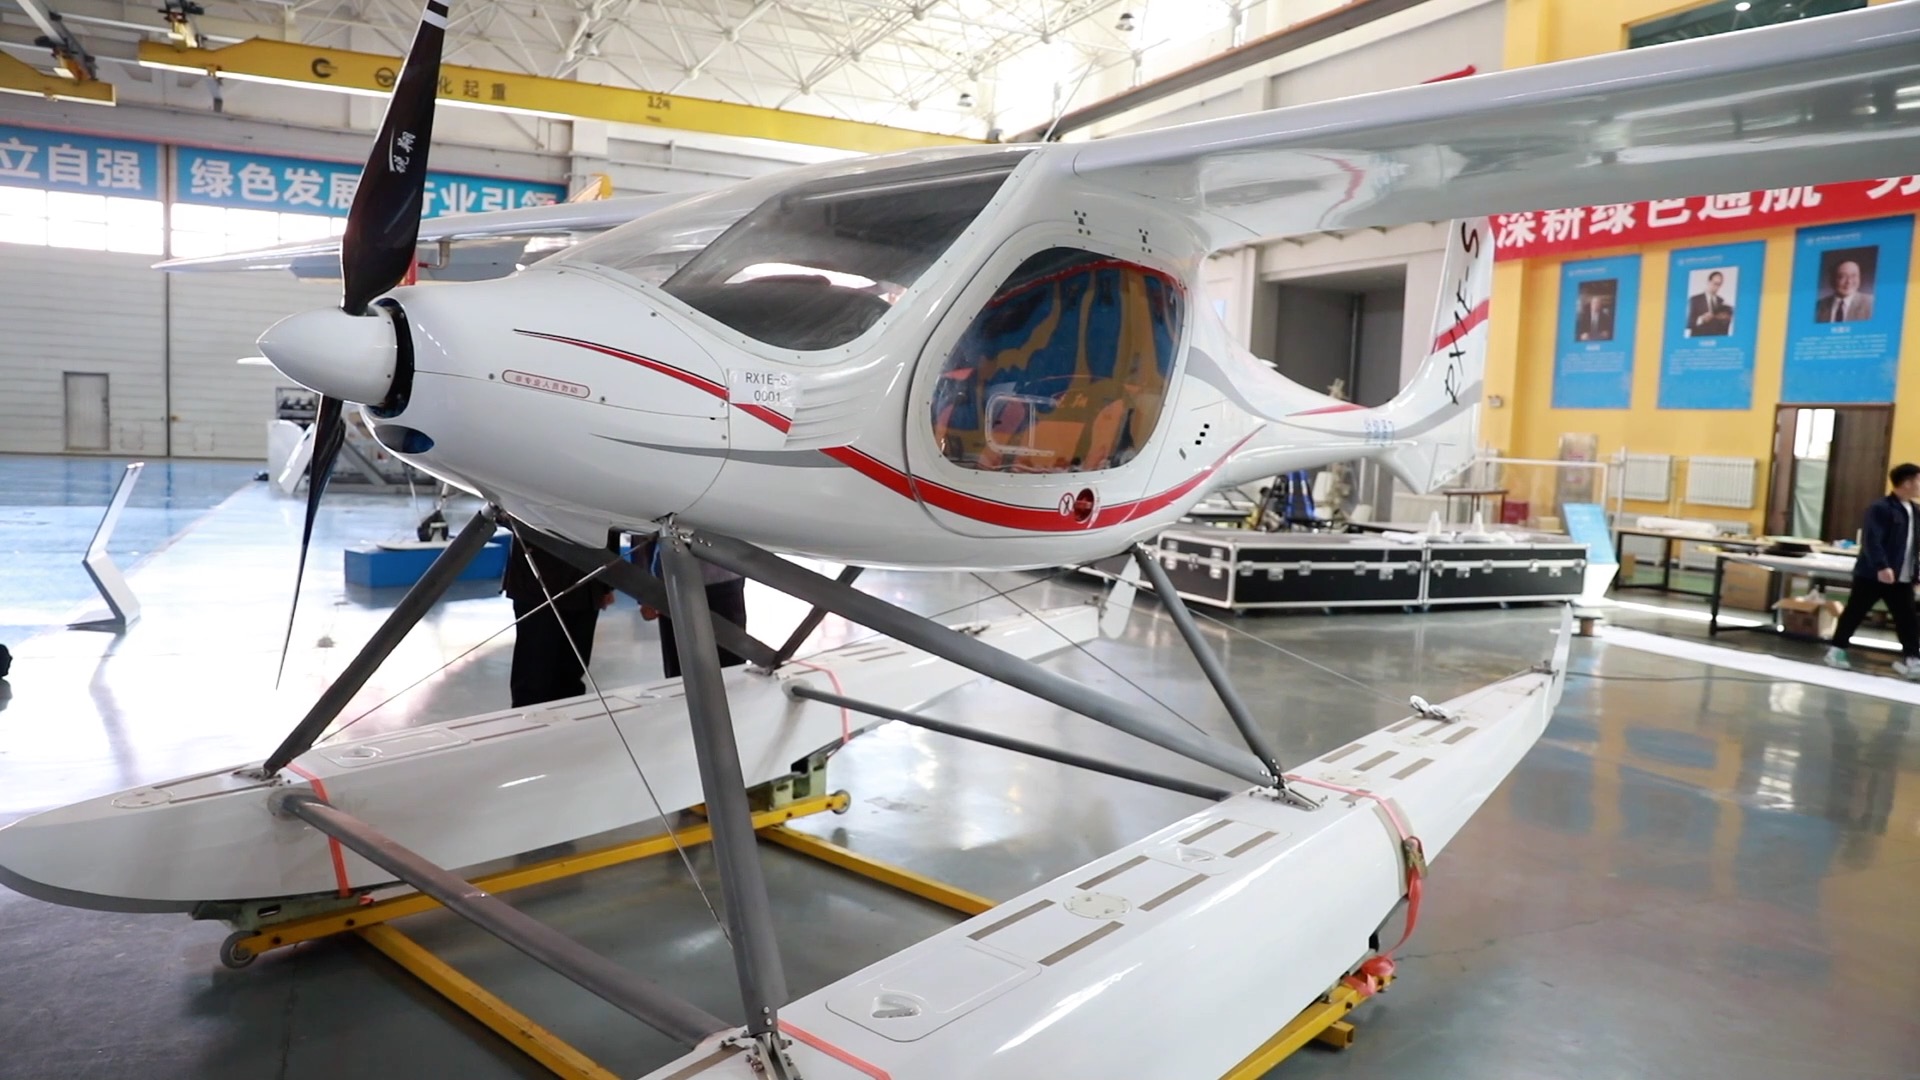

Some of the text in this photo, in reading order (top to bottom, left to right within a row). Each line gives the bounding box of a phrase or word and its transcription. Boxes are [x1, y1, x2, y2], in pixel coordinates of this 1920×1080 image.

[0, 137, 142, 190] 立自强
[191, 157, 362, 210] 绿色发展
[745, 372, 788, 386] RX1E-S
[754, 390, 781, 402] 0001
